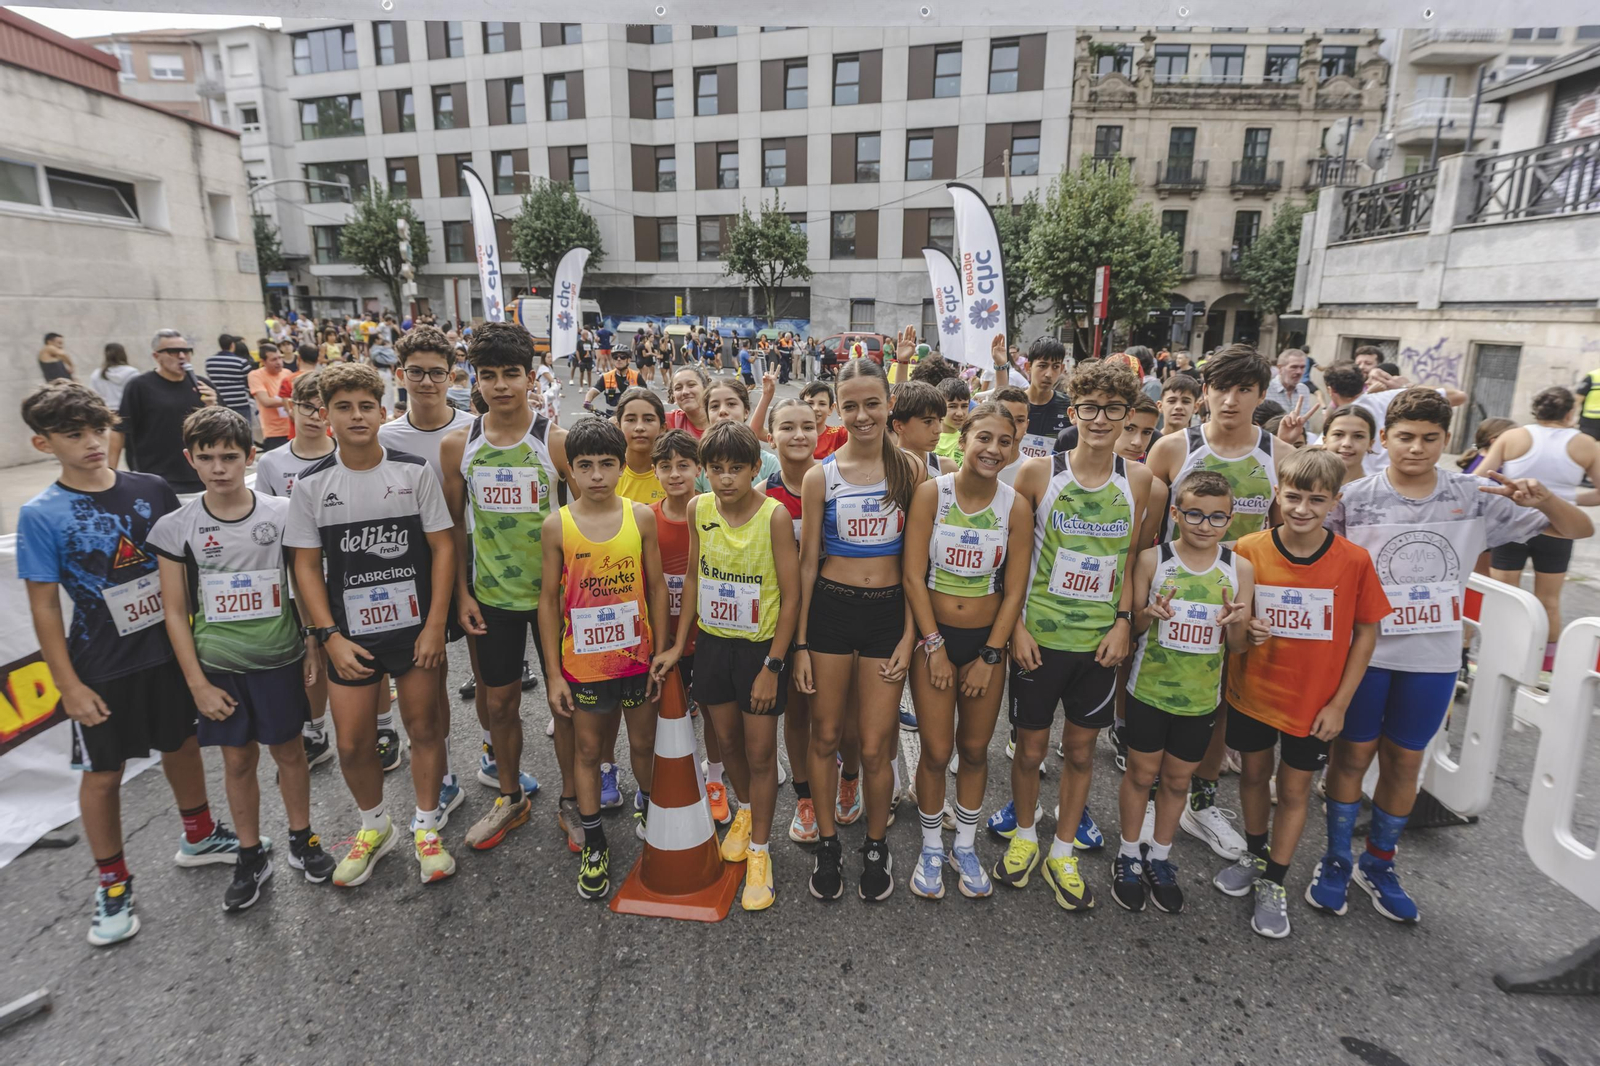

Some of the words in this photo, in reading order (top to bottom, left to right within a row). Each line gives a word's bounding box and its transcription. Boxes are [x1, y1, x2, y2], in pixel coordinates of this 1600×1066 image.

[557, 280, 571, 308] chc
[484, 487, 522, 504] 3203
[848, 518, 888, 537] 3027
[1053, 511, 1129, 534] Natursueño
[340, 524, 408, 552] delikia
[380, 544, 400, 554] fresh
[946, 547, 983, 568] 3013
[1399, 549, 1436, 563] CUMES
[712, 567, 763, 585] Running
[1412, 564, 1424, 572] do
[1062, 572, 1100, 593] 3014
[216, 592, 262, 613] 3206
[862, 590, 894, 599] NIKE
[124, 591, 161, 622] 340
[360, 604, 398, 625] 3021
[710, 600, 737, 622] 3211
[1393, 604, 1441, 625] 3040
[1266, 608, 1312, 630] 3034
[584, 624, 625, 646] 3028
[1168, 622, 1213, 644] 3009
